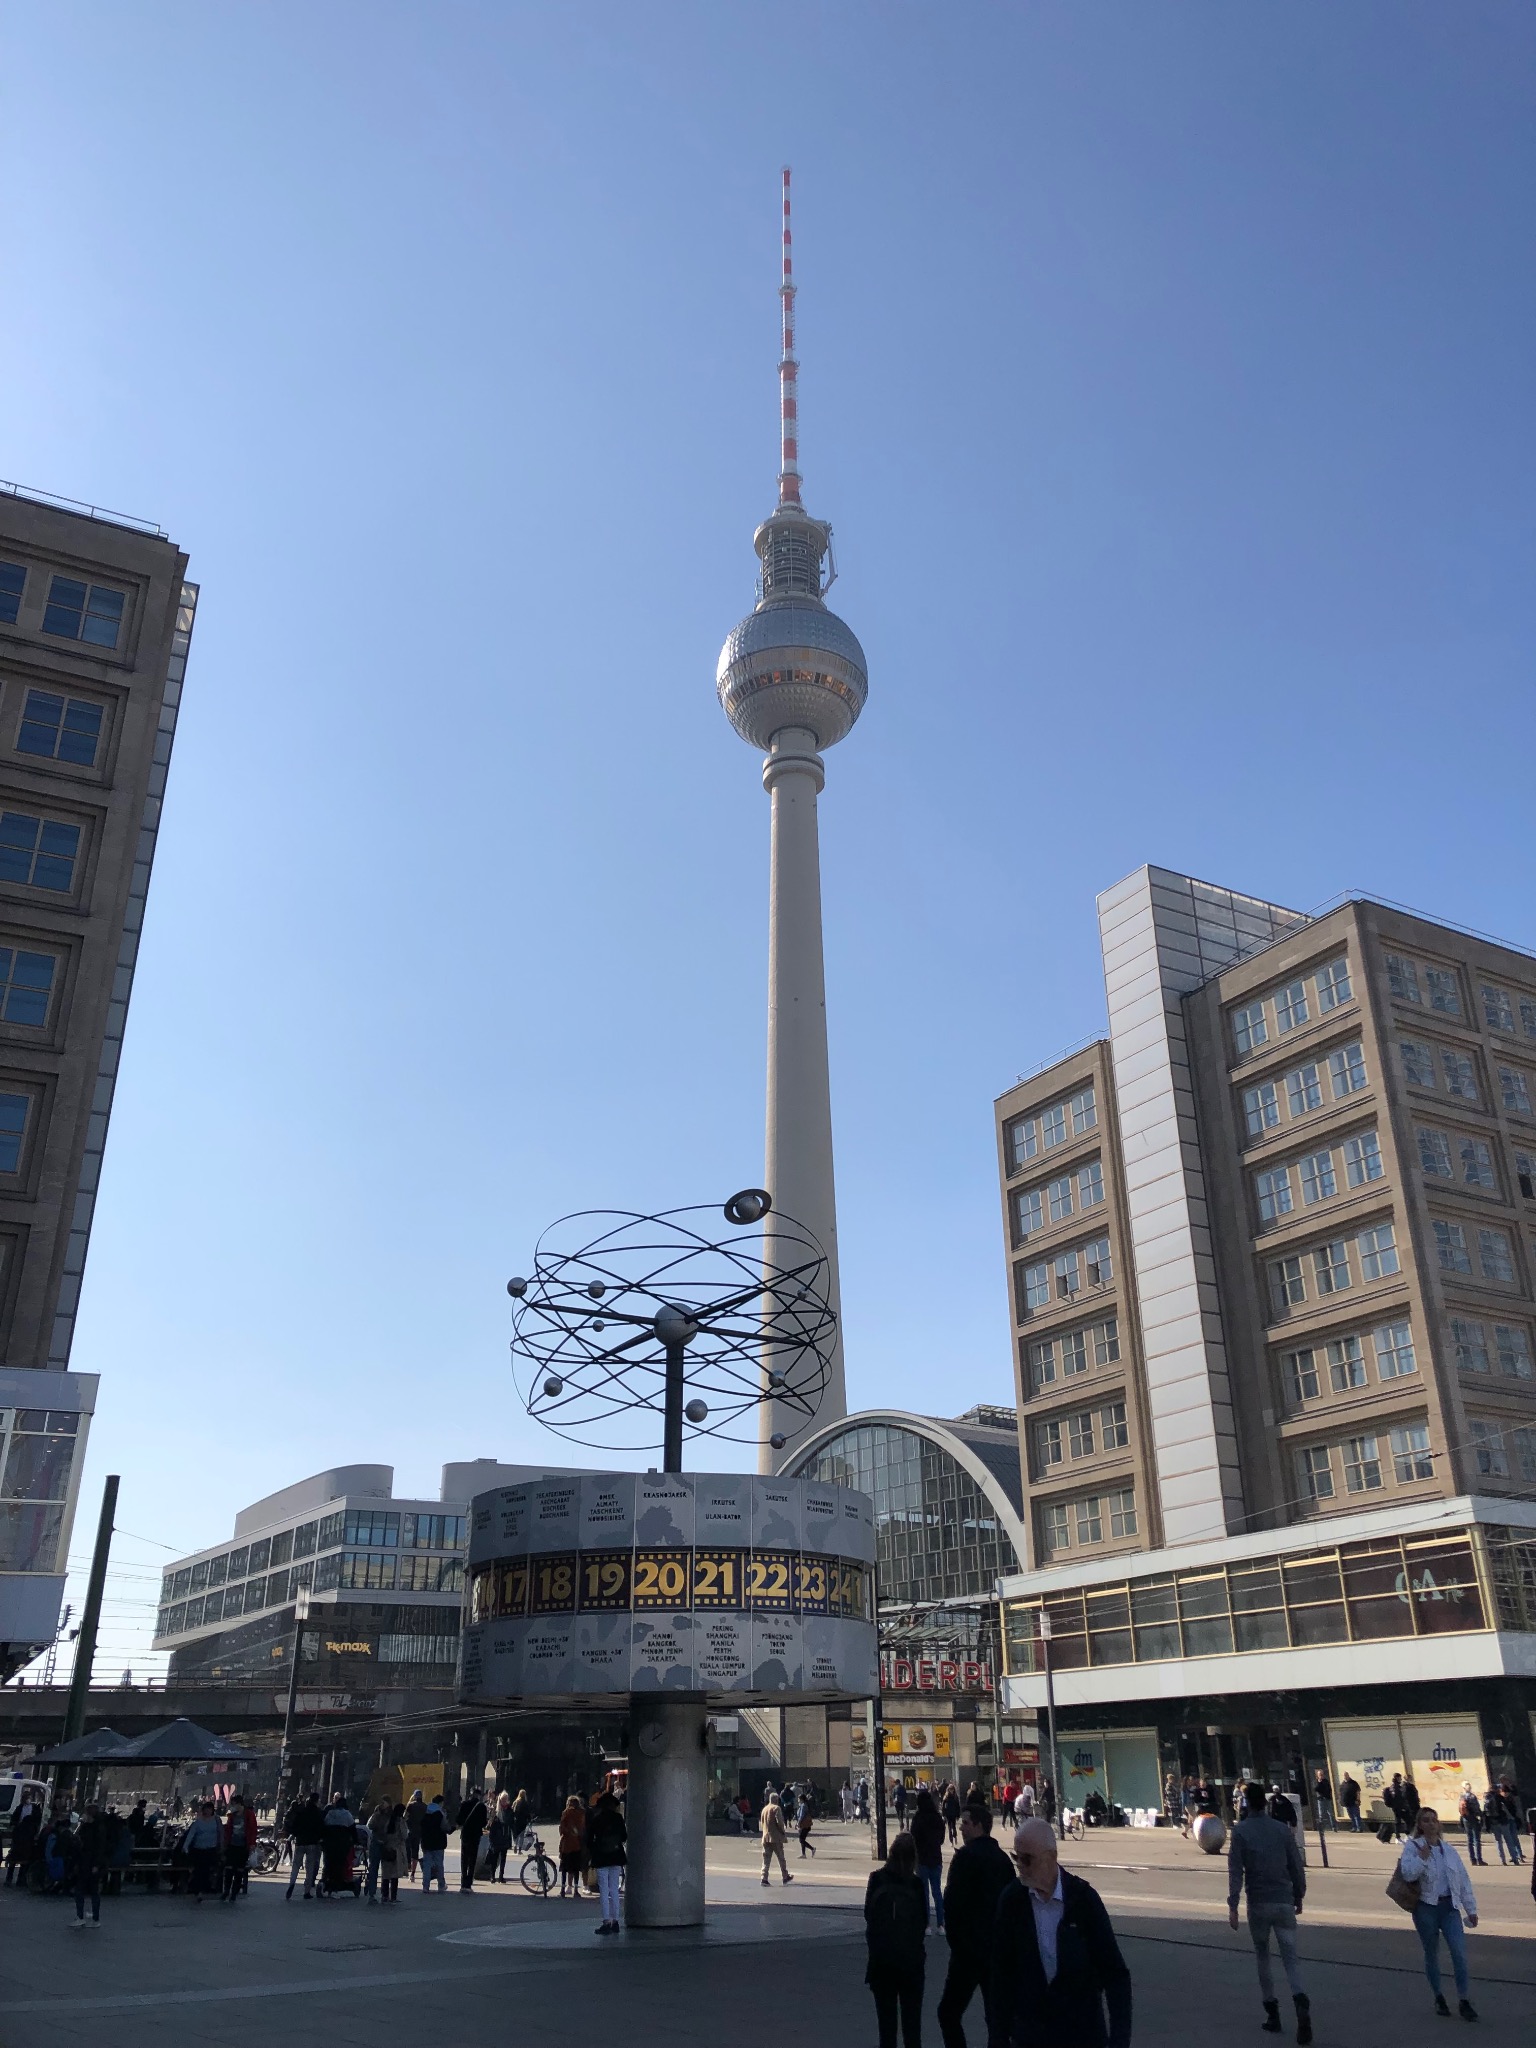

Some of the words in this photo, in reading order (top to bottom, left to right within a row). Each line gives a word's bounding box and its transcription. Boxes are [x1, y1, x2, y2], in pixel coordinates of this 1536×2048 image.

[503, 1570, 527, 1604] 17
[540, 1566, 572, 1600] 18
[585, 1562, 625, 1597] 19
[634, 1561, 685, 1596] 20
[694, 1561, 734, 1595] 21
[746, 1563, 788, 1597] 22
[794, 1566, 826, 1600] 23
[829, 1570, 851, 1604] 24
[887, 1754, 935, 1764] McDonald's
[1074, 1748, 1092, 1766] dm
[1432, 1742, 1457, 1761] dm
